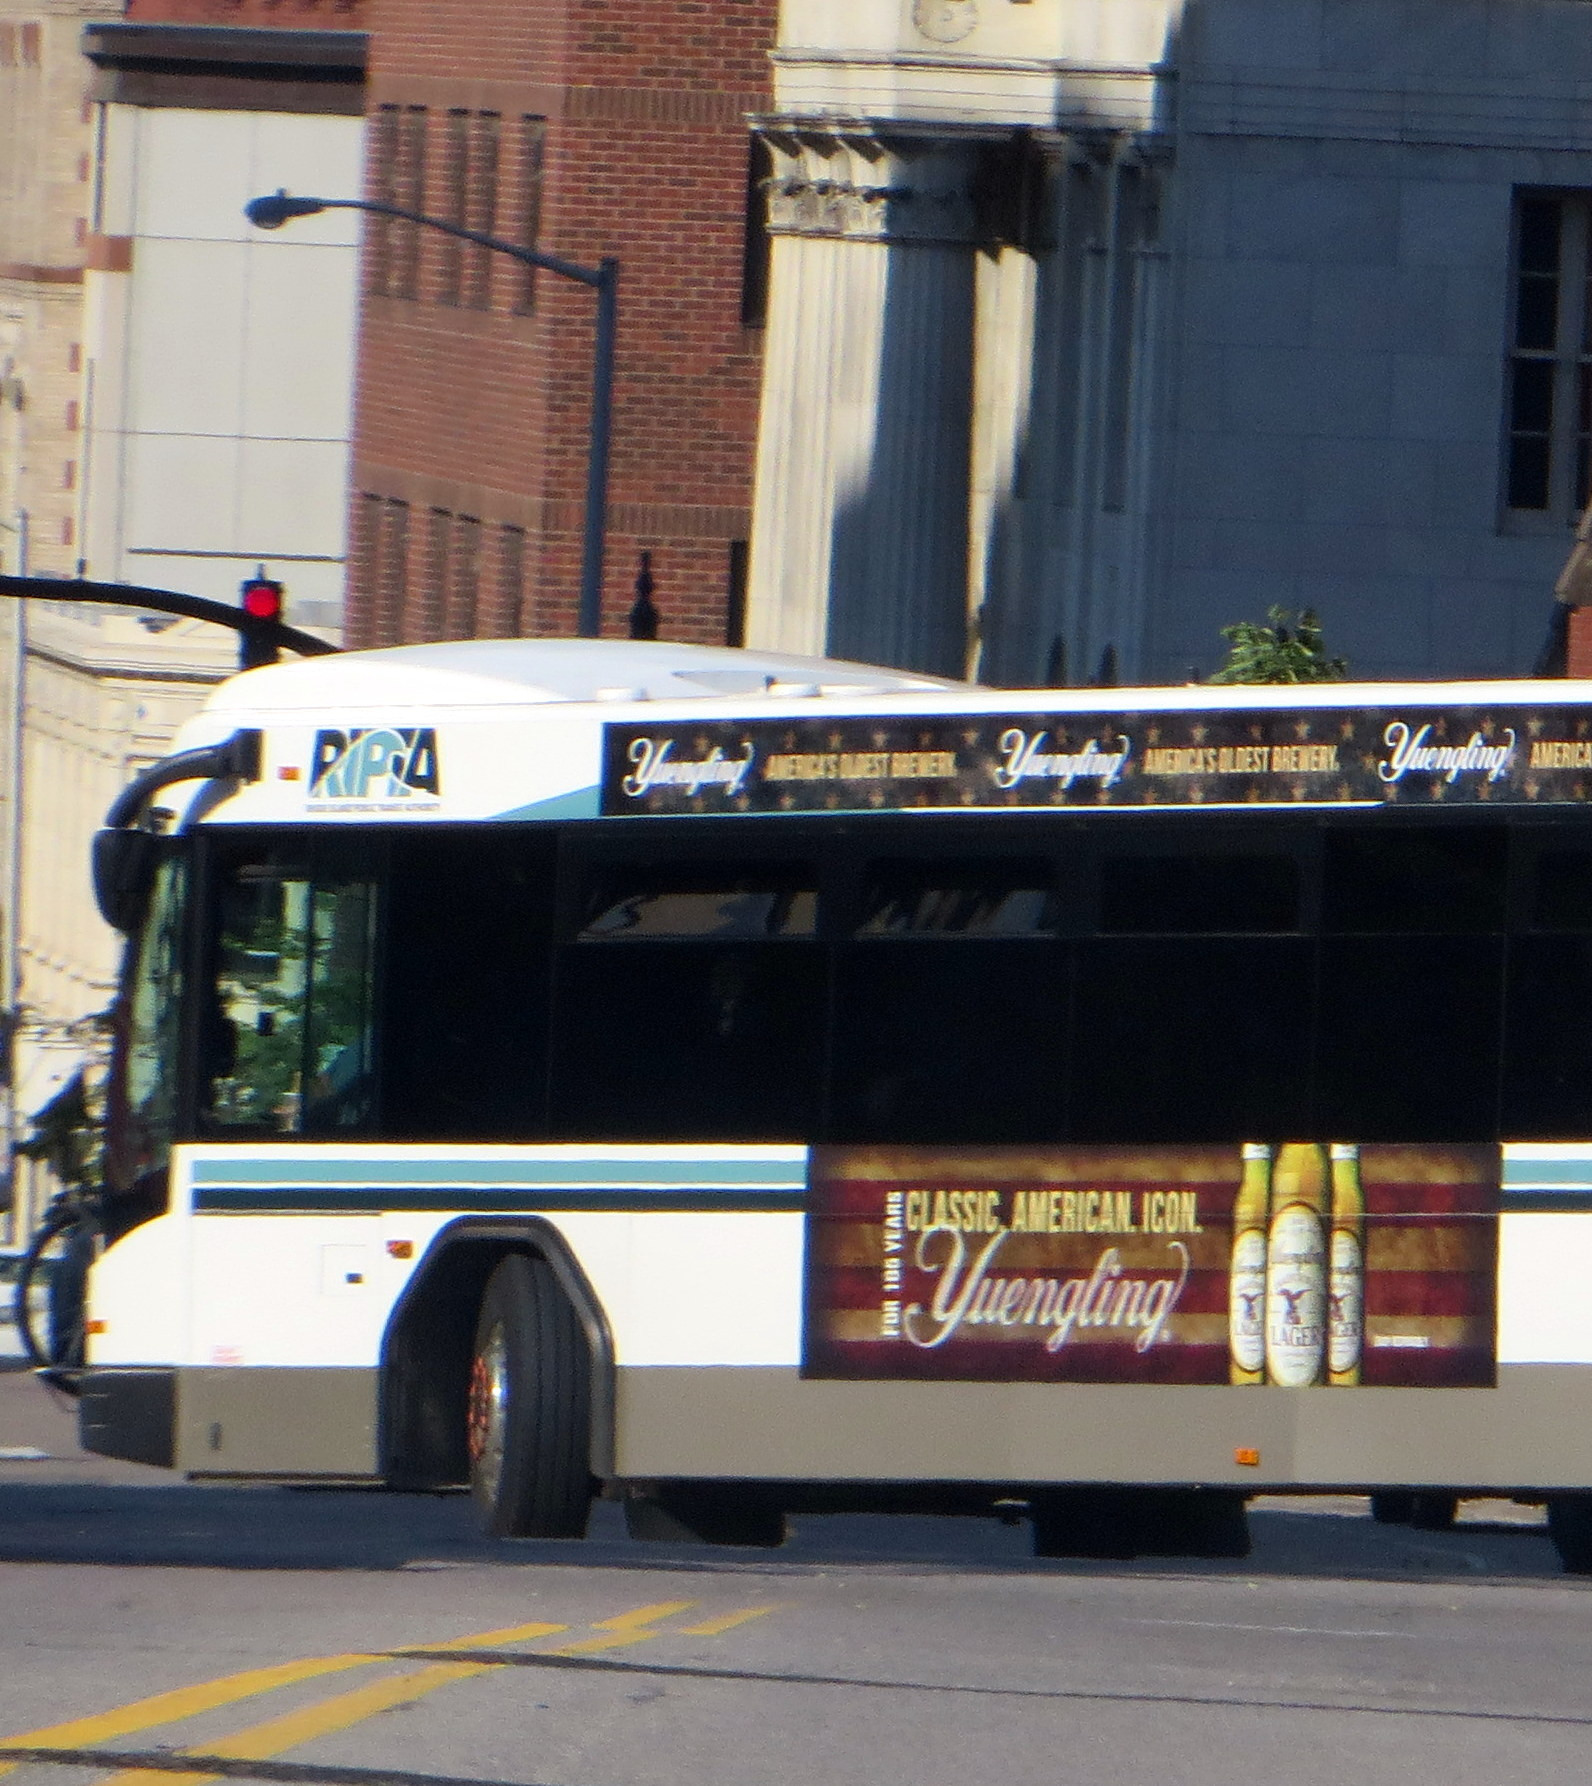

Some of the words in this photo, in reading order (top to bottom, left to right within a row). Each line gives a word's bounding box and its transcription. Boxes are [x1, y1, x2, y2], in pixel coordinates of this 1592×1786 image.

[994, 728, 1131, 789] Yuengling
[1377, 721, 1516, 783] Yuengling
[903, 1224, 1190, 1353] Yuengling
